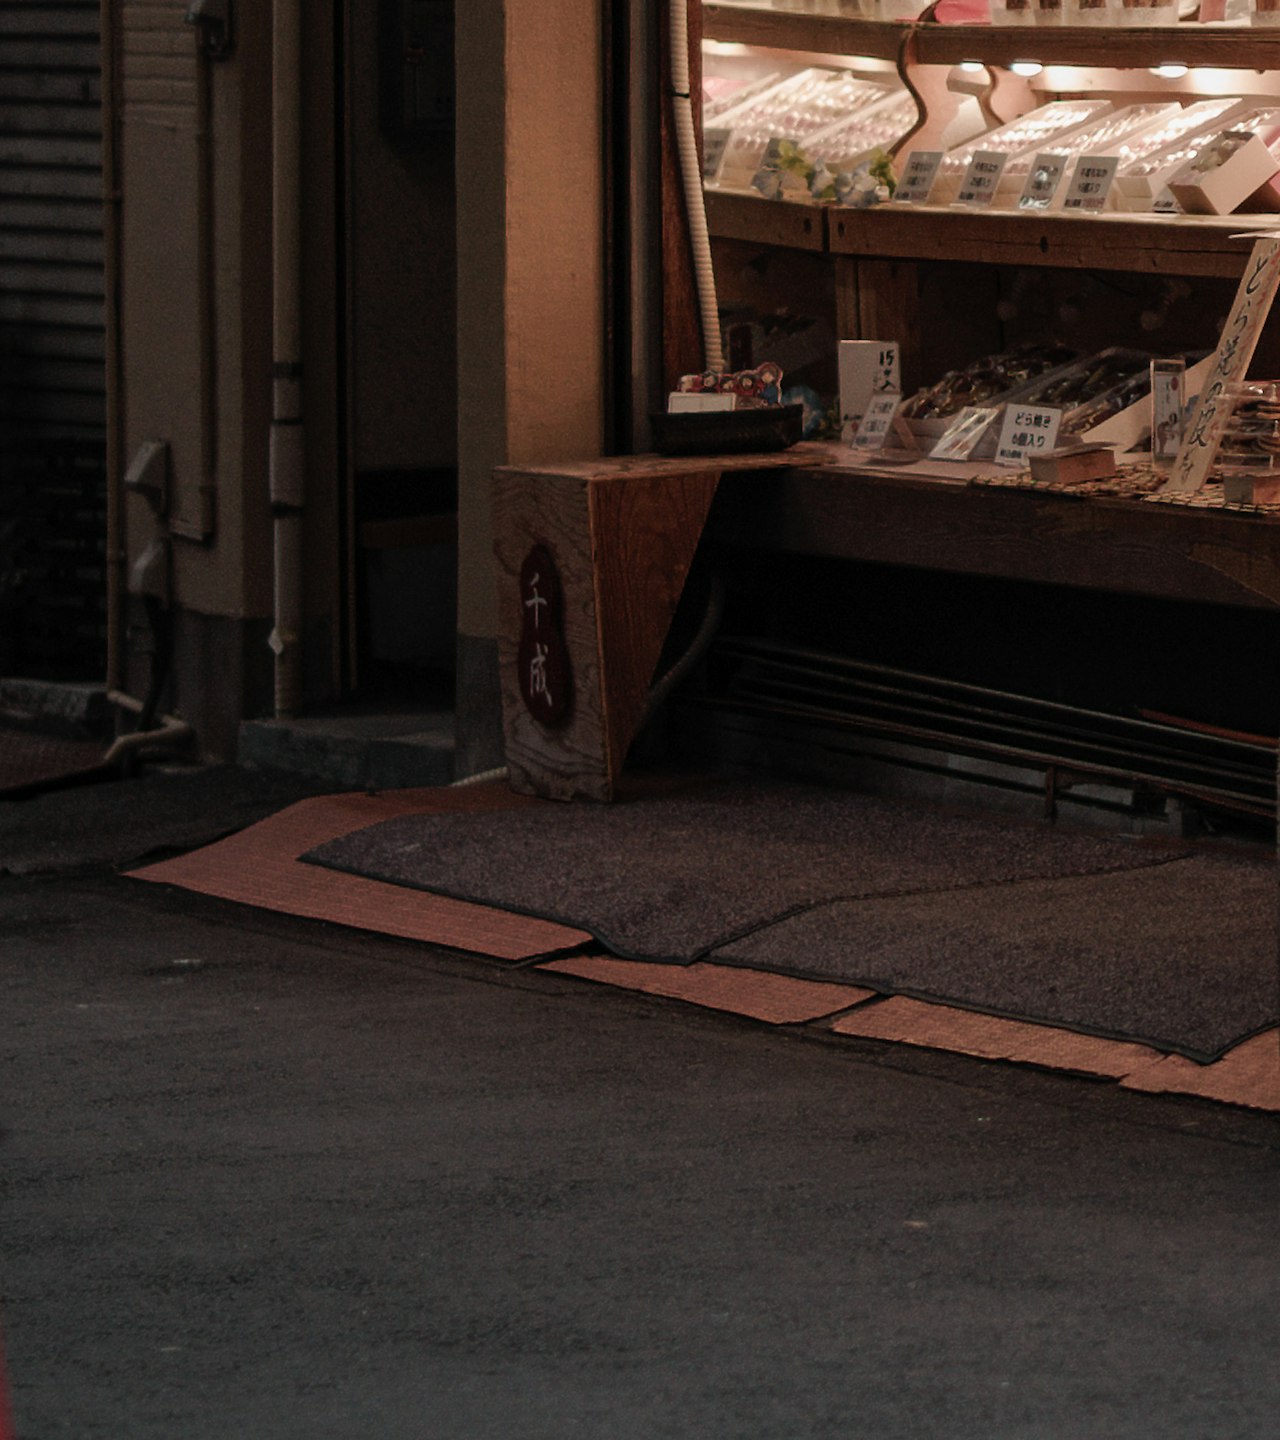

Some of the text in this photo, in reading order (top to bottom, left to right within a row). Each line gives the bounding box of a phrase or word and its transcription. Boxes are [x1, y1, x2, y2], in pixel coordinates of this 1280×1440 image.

[1015, 412, 1052, 428] どら焼き
[523, 571, 554, 708] 千成
